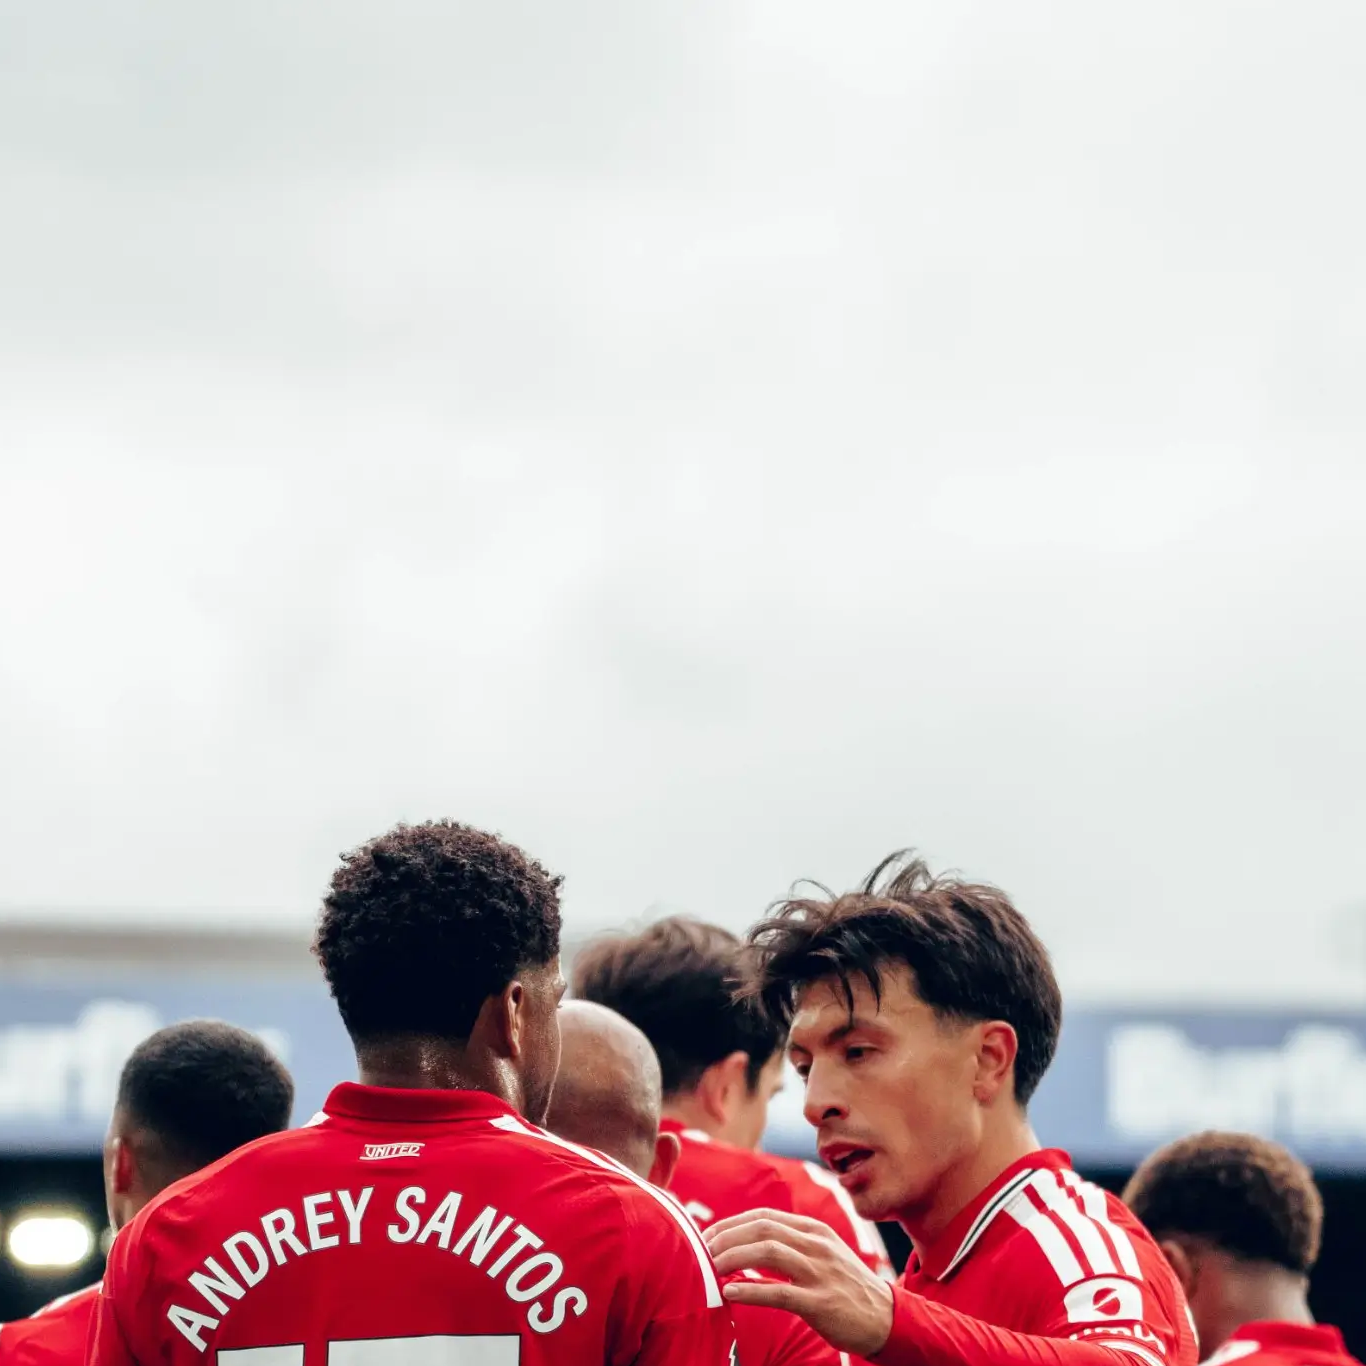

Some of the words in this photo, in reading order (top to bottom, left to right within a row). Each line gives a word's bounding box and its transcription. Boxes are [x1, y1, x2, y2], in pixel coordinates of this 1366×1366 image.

[362, 1143, 422, 1159] UNITED
[166, 1186, 375, 1352] ANDREY
[387, 1186, 588, 1335] SANTOS
